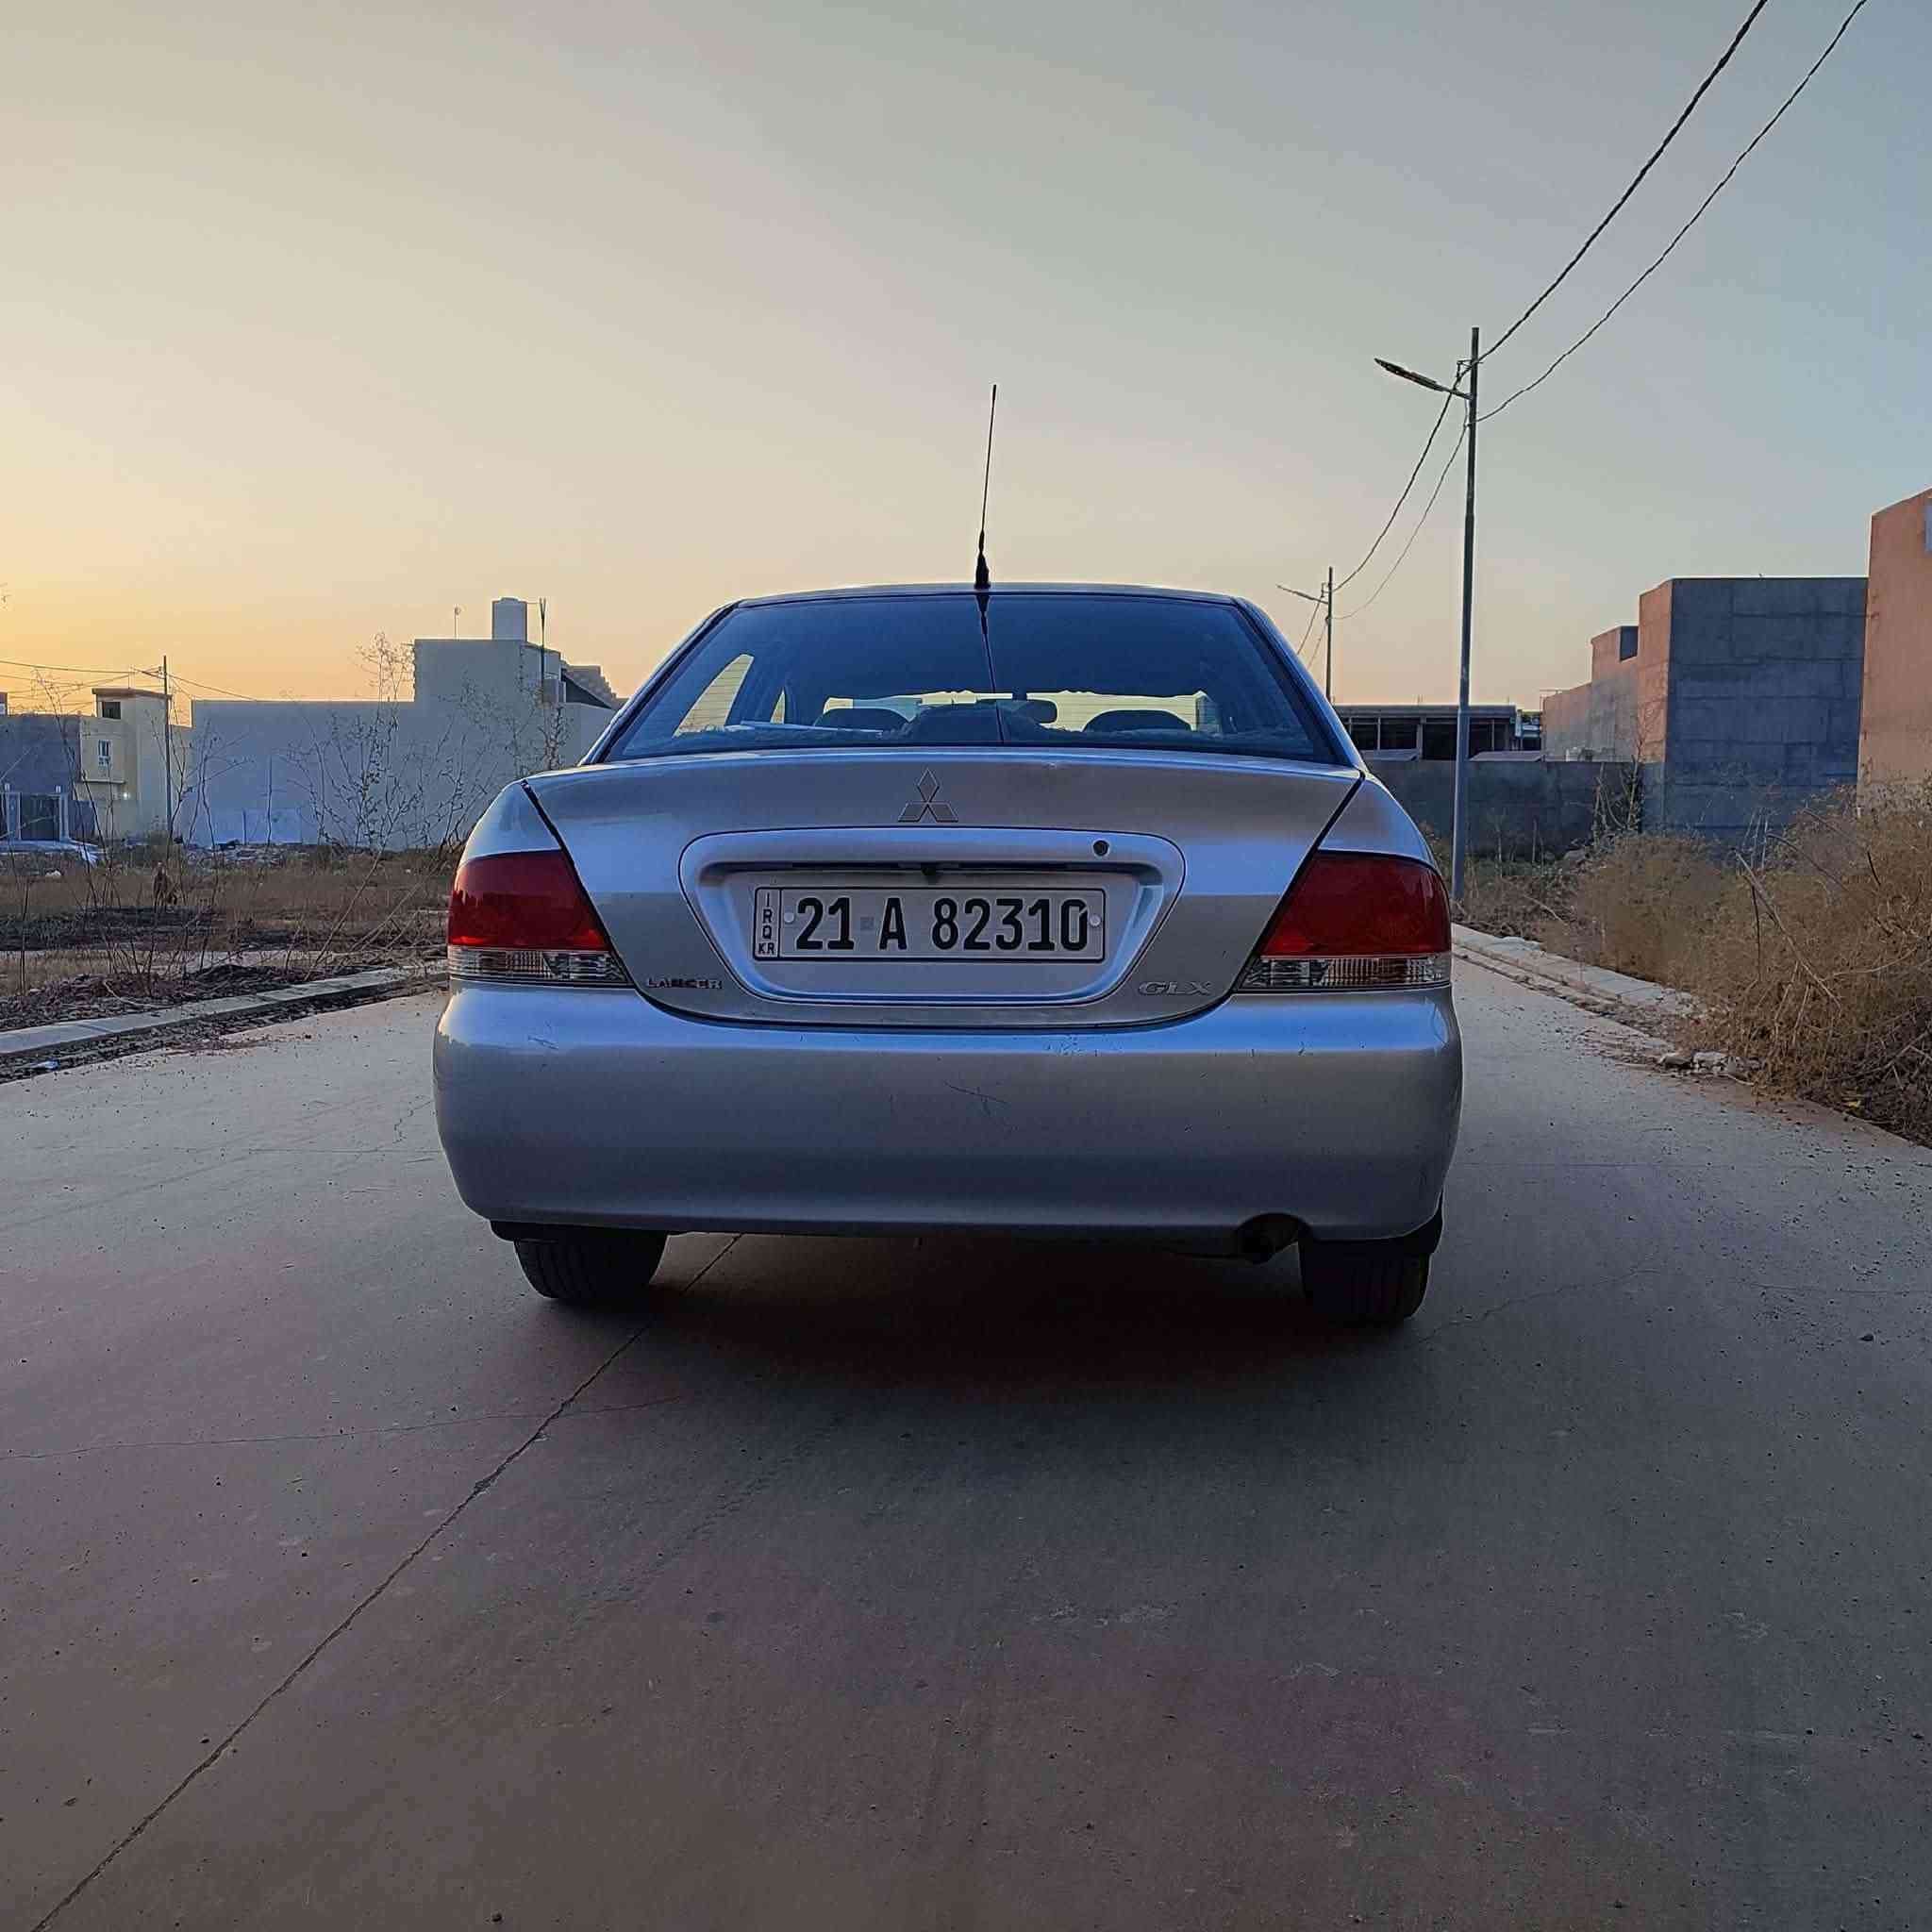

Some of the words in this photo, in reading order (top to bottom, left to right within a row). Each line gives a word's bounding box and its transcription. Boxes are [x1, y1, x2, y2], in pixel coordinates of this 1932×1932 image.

[796, 897, 854, 950] 21
[879, 897, 908, 950] A
[932, 897, 1088, 951] 82310
[758, 942, 774, 955] KR
[1139, 981, 1212, 995] GLX
